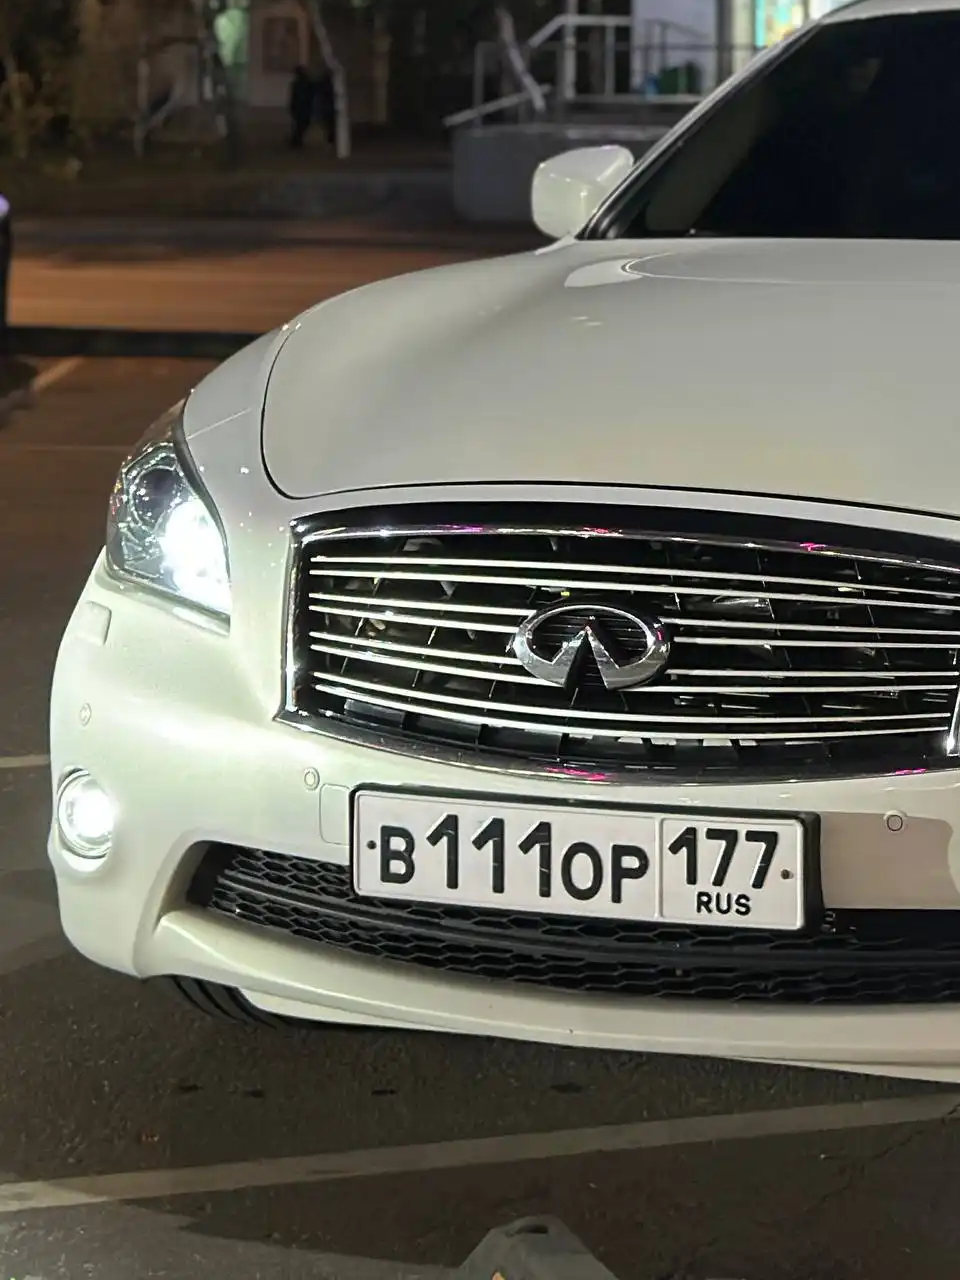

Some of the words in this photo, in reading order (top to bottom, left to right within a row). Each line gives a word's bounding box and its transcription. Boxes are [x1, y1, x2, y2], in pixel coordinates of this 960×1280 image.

[379, 813, 650, 905] В111ОР
[668, 826, 779, 890] 177
[696, 891, 752, 917] RUS
